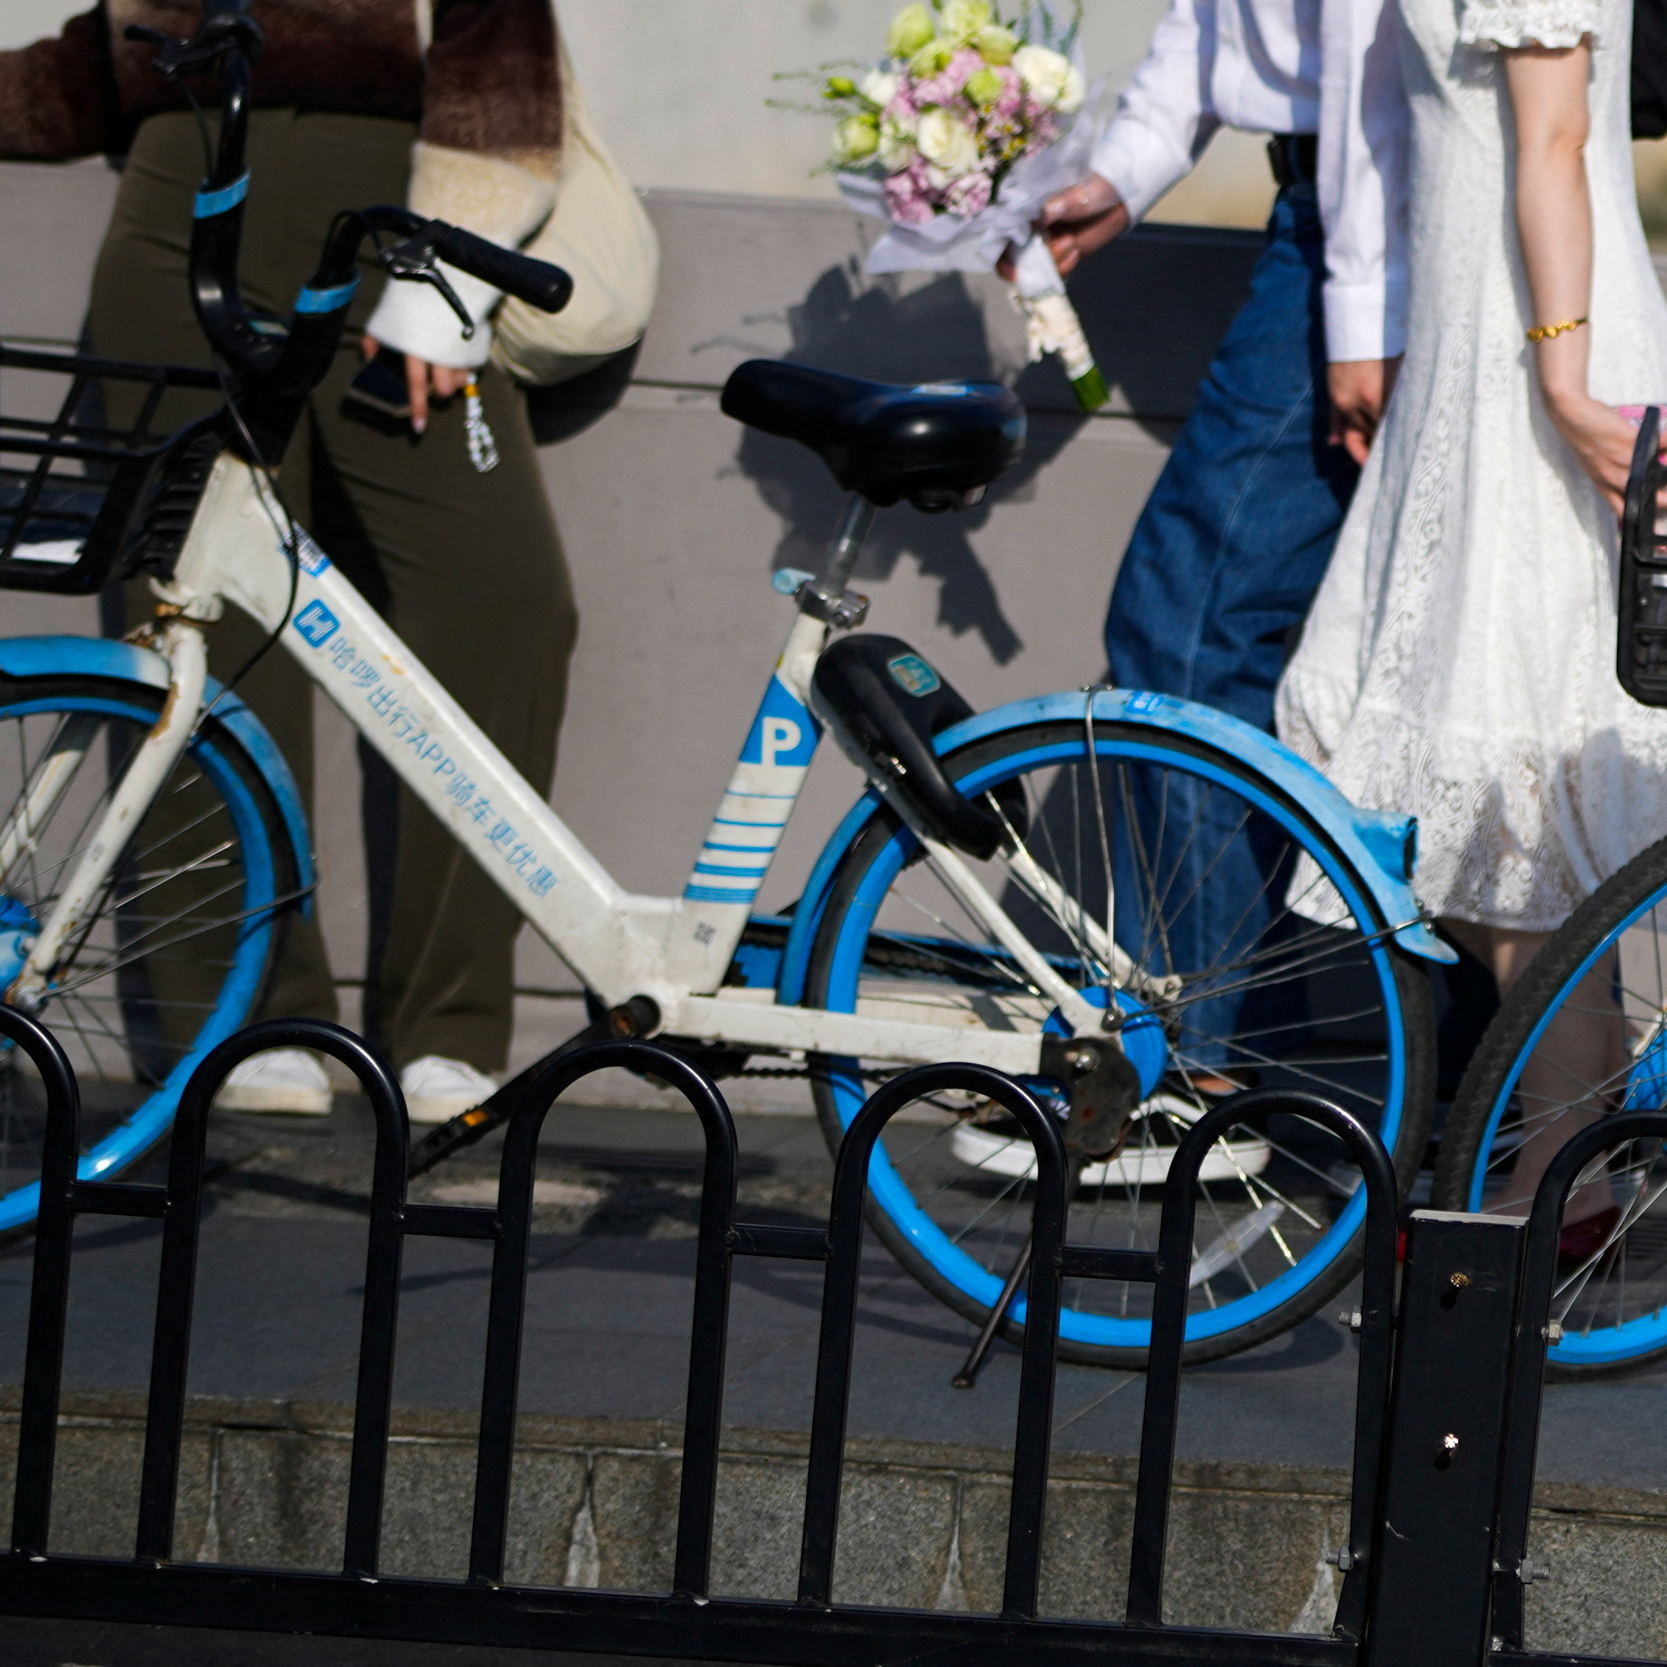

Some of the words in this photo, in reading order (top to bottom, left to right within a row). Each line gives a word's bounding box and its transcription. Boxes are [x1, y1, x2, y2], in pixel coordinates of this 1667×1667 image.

[328, 637, 558, 898] 哈啰出行APP骑车更优惠
[759, 717, 801, 766] P
